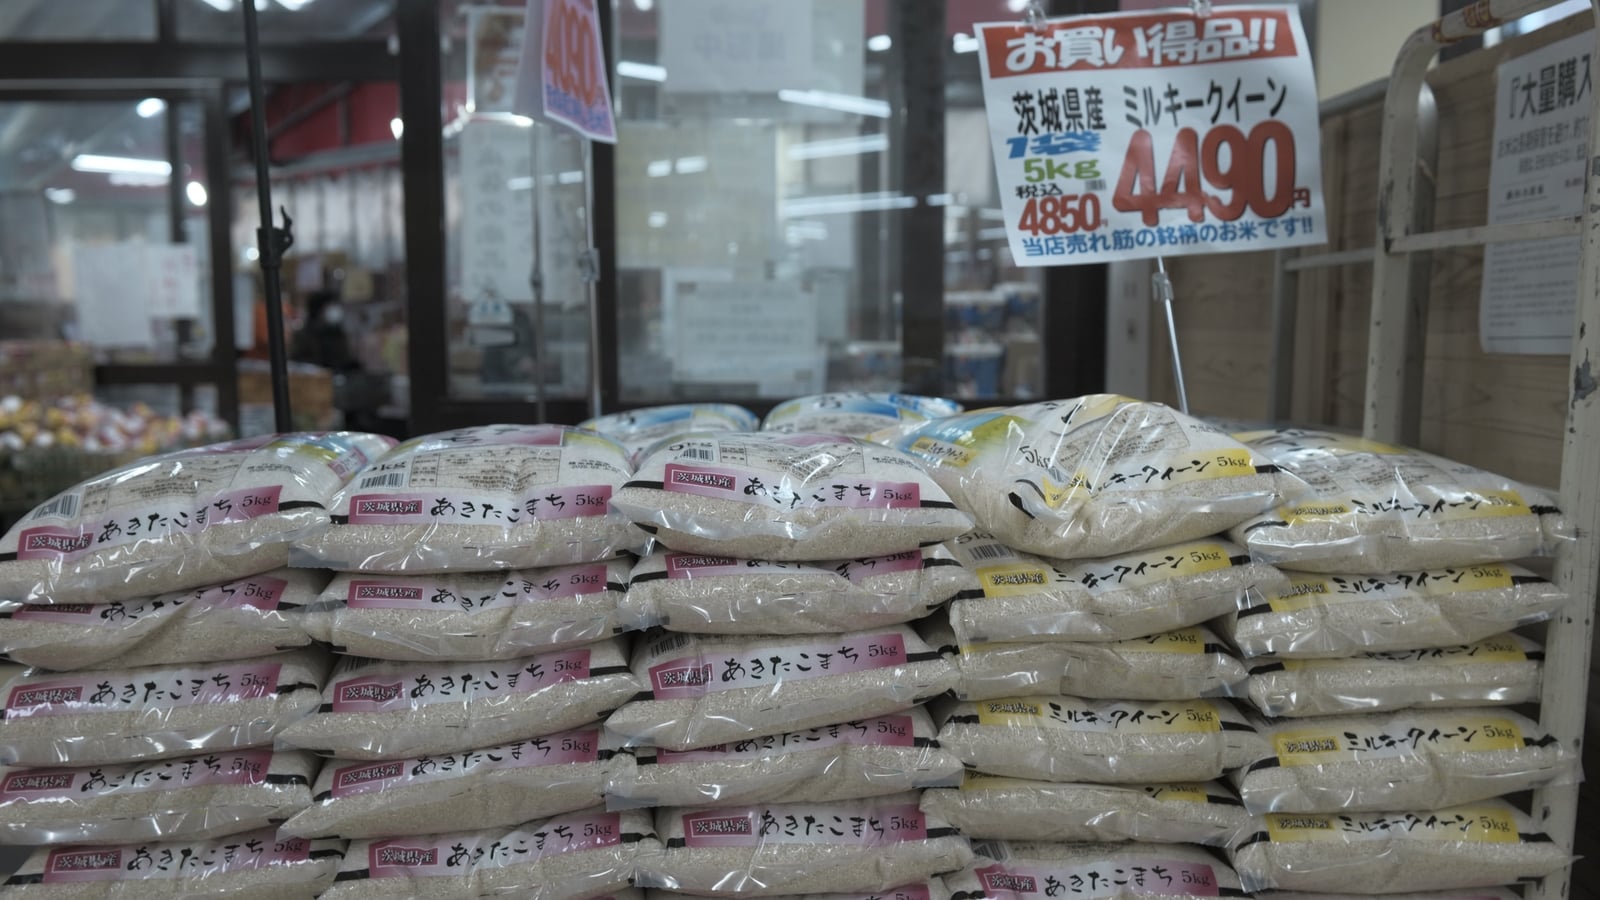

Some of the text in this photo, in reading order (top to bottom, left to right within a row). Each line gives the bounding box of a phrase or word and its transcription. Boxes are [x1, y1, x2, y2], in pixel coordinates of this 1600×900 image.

[1006, 17, 1277, 72] お買い得品!!
[1012, 77, 1287, 135] 茨城県産 ミルキークイーン
[1024, 158, 1100, 183] 5kg
[1015, 184, 1062, 199] 税込
[1022, 216, 1313, 257] 当店売れ筋の銘柄のお米です!!
[1217, 457, 1247, 468] 5kg
[676, 472, 732, 488] 茨城県産
[883, 488, 914, 501] 5kg
[362, 493, 605, 522] 茨城県産 あきたこまち 5kg
[32, 494, 272, 553] 茨城県産 あきたこまち 5kg
[1190, 550, 1221, 563] 5kg
[360, 587, 419, 599] 茨城県産
[570, 574, 600, 585] 5kg
[1473, 567, 1503, 579] 5kg
[244, 583, 274, 599] 5kg
[722, 646, 859, 682] あきたこまち
[868, 644, 898, 658] 5kg
[20, 672, 270, 704] 茨城県産 あきたこまち 5kg
[346, 659, 582, 699] 茨城県産 あきたこまち 5kg
[877, 721, 906, 737] 5kg
[1049, 702, 1180, 728] ミルキークイーン
[1186, 708, 1212, 723] 5kg
[1343, 726, 1477, 751] ミルキークイーン
[1483, 725, 1515, 740] 5kg
[11, 755, 260, 792] 茨城県産 あきたこまち 5kg
[344, 738, 591, 784] 茨城県産 あきたこまち 5kg
[695, 810, 919, 839] 茨城県産 あきたこまち 5kg
[1339, 814, 1475, 832] ミルキークイーン
[1480, 816, 1511, 831] 5kg
[58, 853, 117, 869] 茨城県産
[127, 838, 264, 871] あきたこまち
[381, 823, 613, 868] 茨城県産 あきたこまち 5kg
[1045, 866, 1173, 897] あきたこまち
[1182, 871, 1211, 885] 5kg
